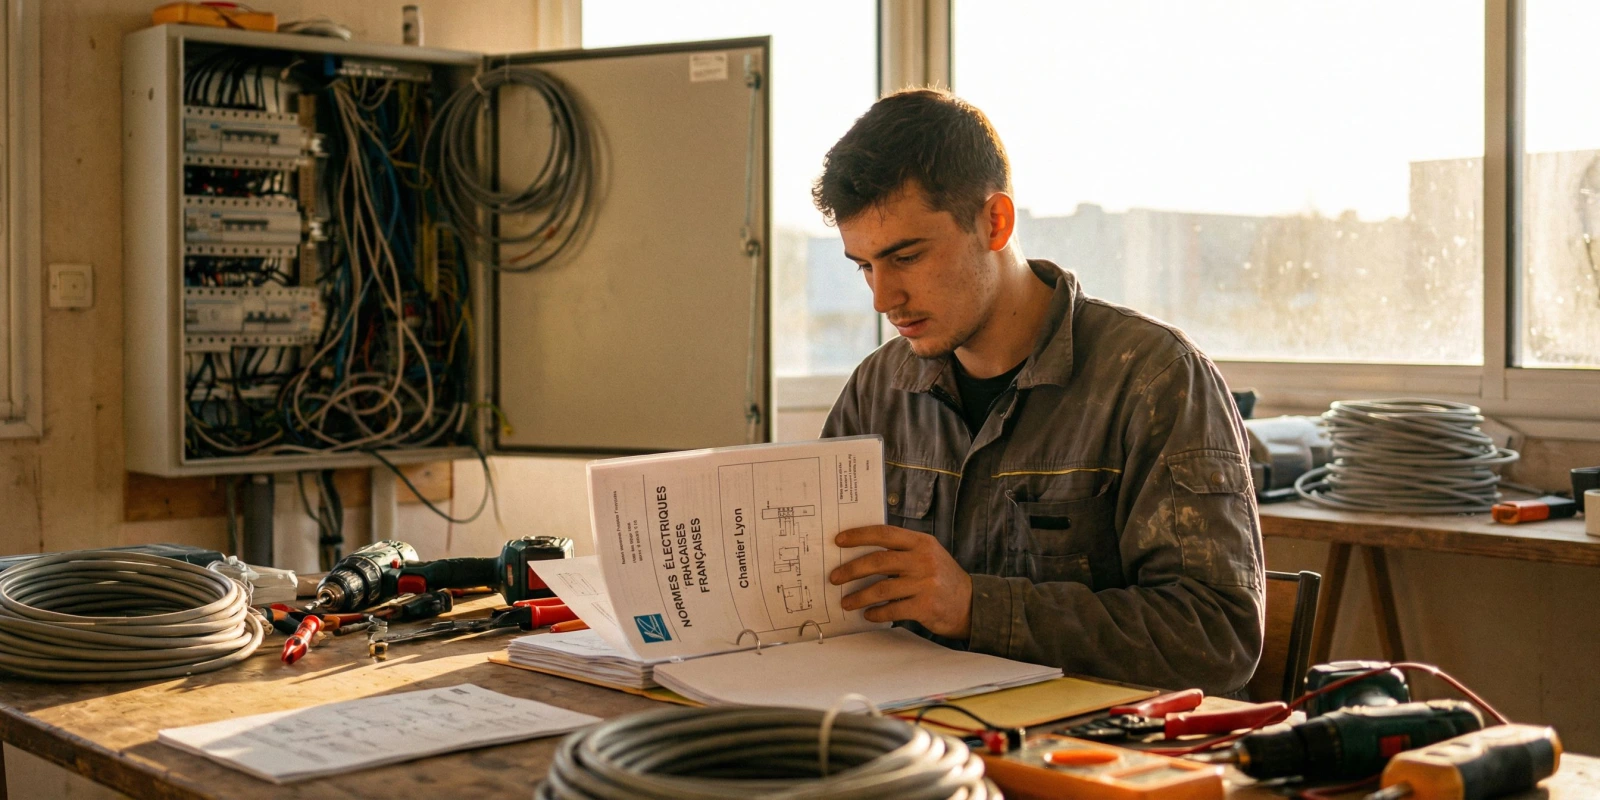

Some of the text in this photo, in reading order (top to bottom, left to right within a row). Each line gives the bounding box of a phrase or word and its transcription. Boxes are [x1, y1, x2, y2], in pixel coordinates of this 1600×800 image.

[656, 485, 692, 627] NORMES ÉLECTRIQUES
[691, 517, 710, 593] FRANÇAISES
[734, 508, 749, 589] Chantier Lyon
